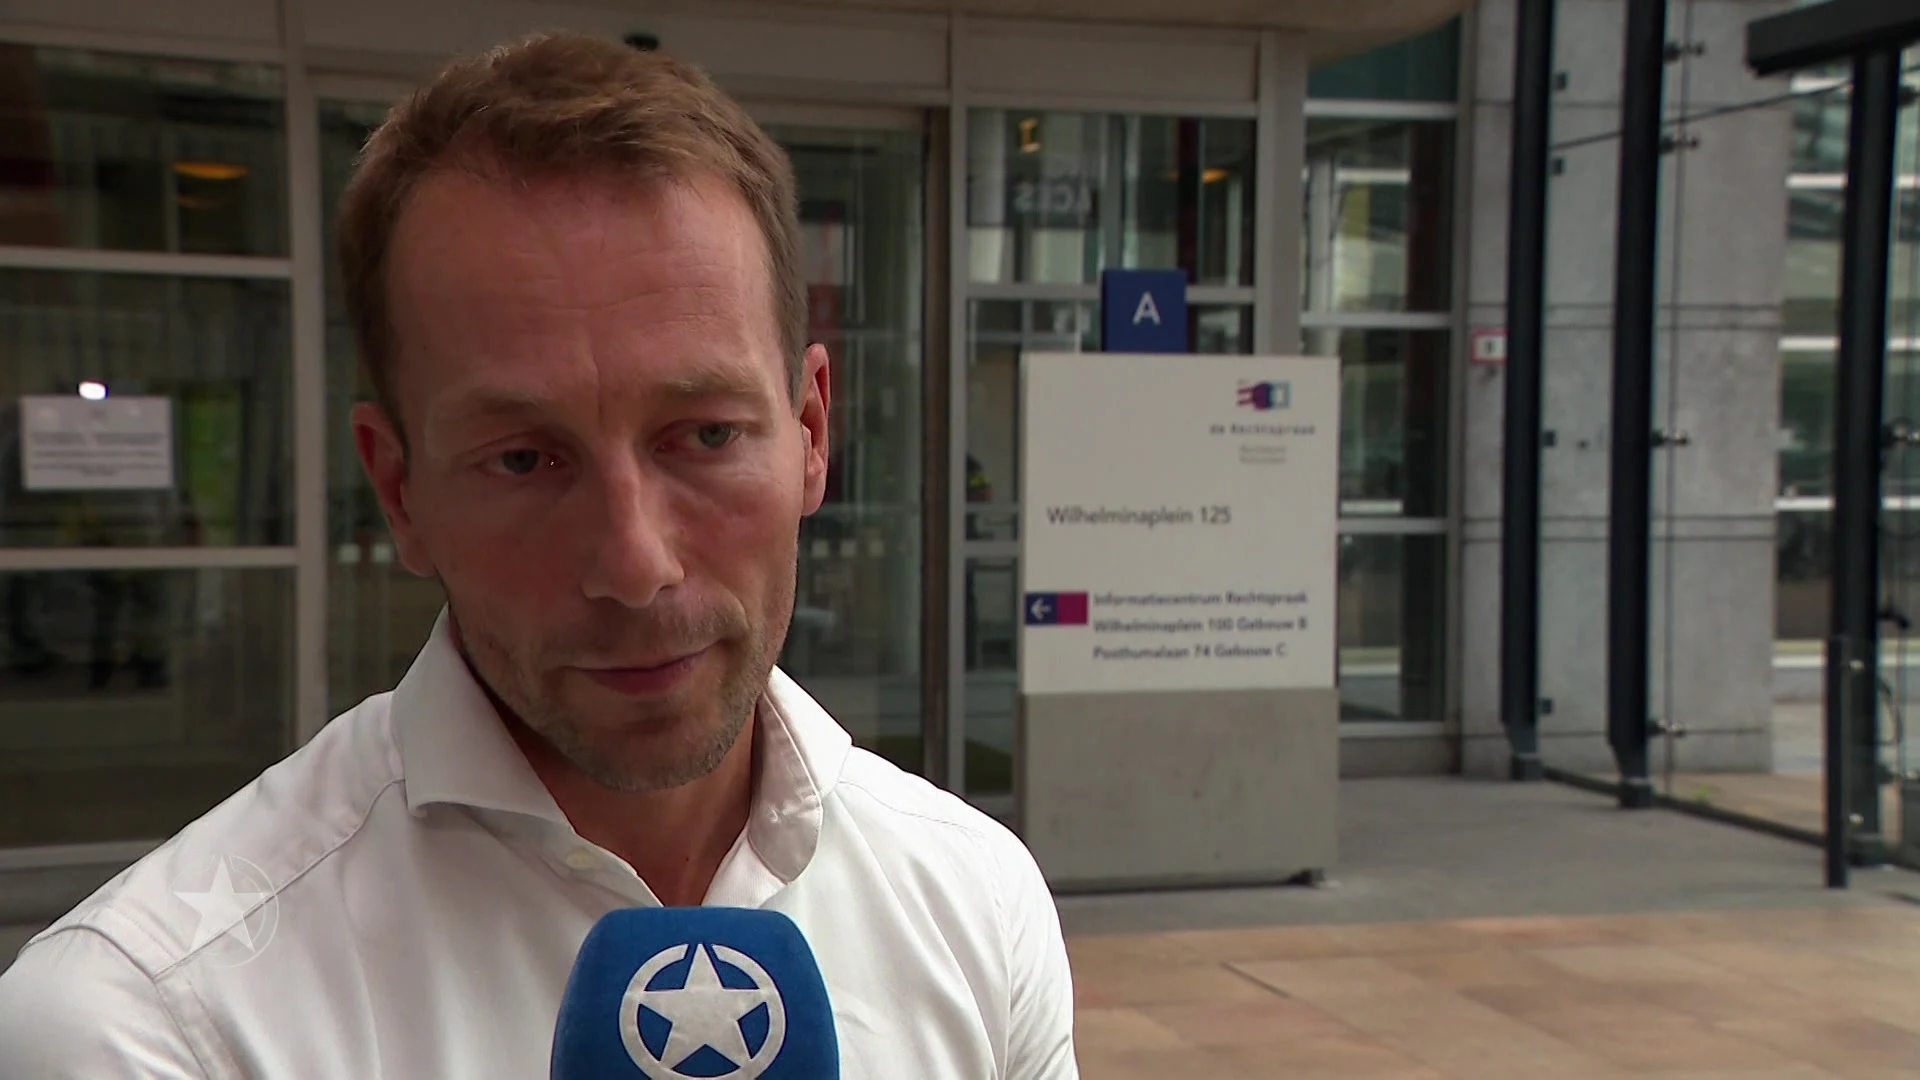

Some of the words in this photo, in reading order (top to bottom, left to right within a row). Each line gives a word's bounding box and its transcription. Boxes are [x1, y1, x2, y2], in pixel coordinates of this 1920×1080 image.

[1132, 291, 1161, 325] A
[1046, 505, 1194, 530] Wilhelminaplein
[1201, 506, 1232, 524] 125
[1094, 617, 1204, 633] Wilhelminaplein
[1209, 617, 1233, 631] 100
[1237, 616, 1294, 631] Gebouw
[1194, 644, 1211, 658] 74
[1214, 644, 1272, 658] Gebouw
[1276, 643, 1287, 657] C
